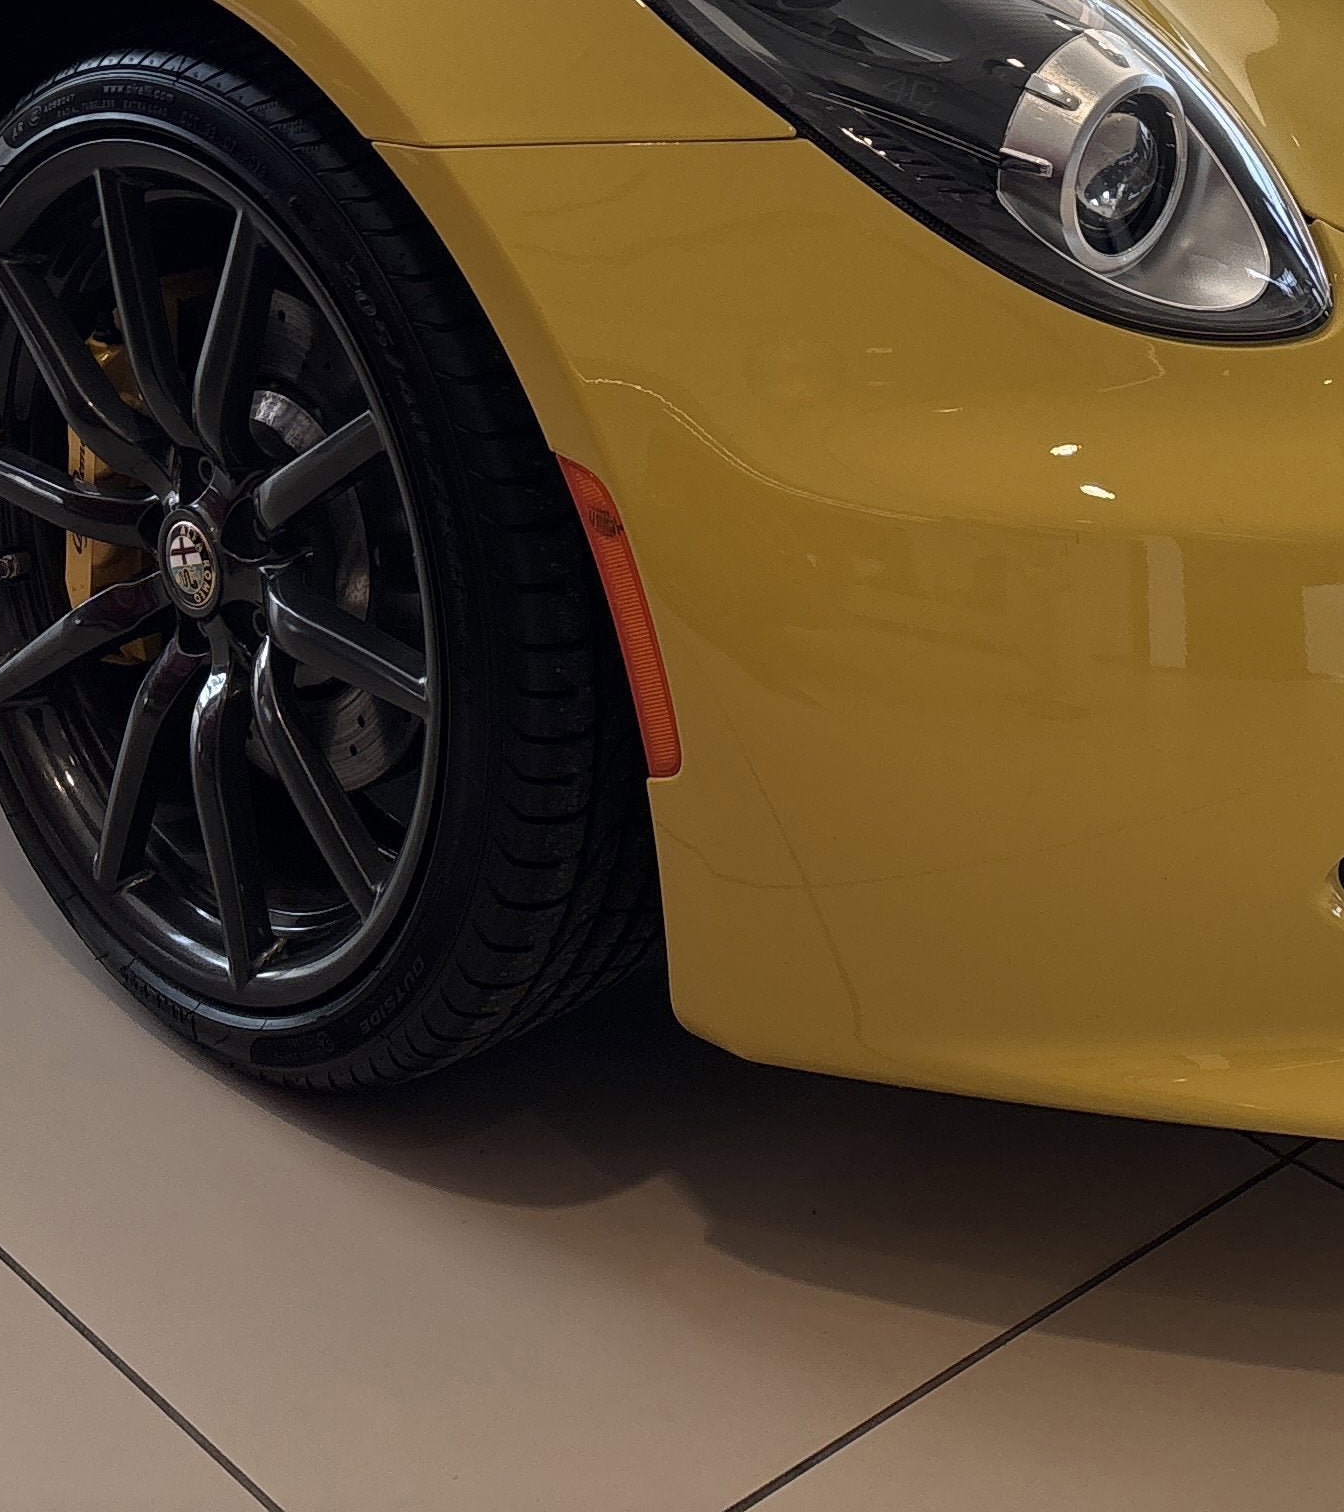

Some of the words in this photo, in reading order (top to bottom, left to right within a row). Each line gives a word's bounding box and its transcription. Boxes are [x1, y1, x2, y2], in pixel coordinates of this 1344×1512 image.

[179, 525, 203, 553] ALFA
[193, 559, 214, 603] ROMEO
[358, 953, 426, 1035] OUTSIDE
